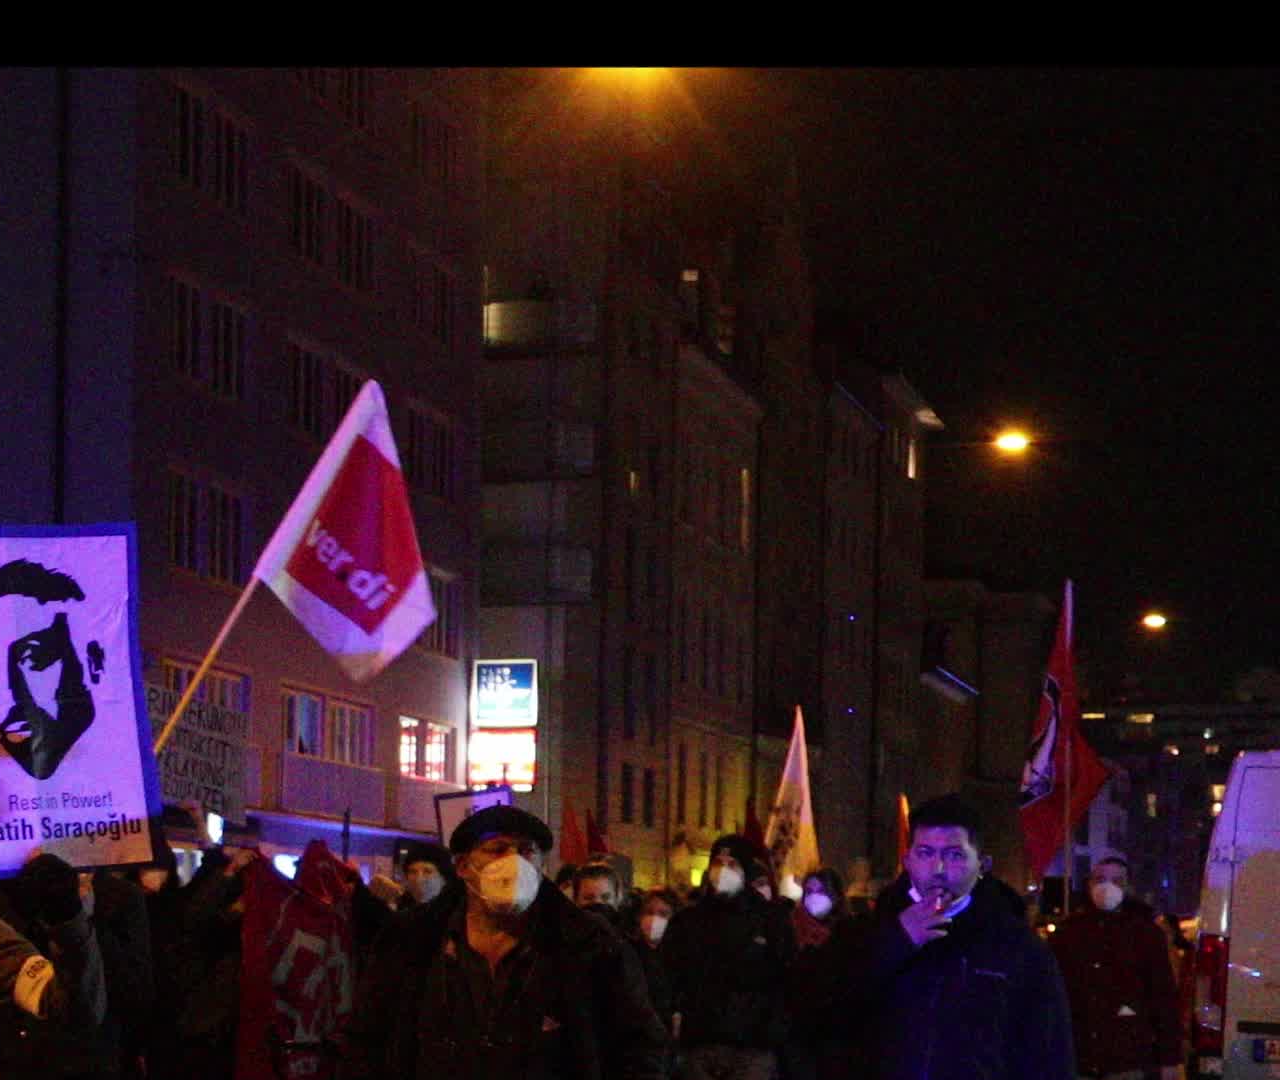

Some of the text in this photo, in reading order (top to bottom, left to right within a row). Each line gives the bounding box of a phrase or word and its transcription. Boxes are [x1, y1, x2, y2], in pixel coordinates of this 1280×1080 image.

[8, 791, 113, 811] Rest in Power!
[42, 812, 142, 844] Saraçoğlu
